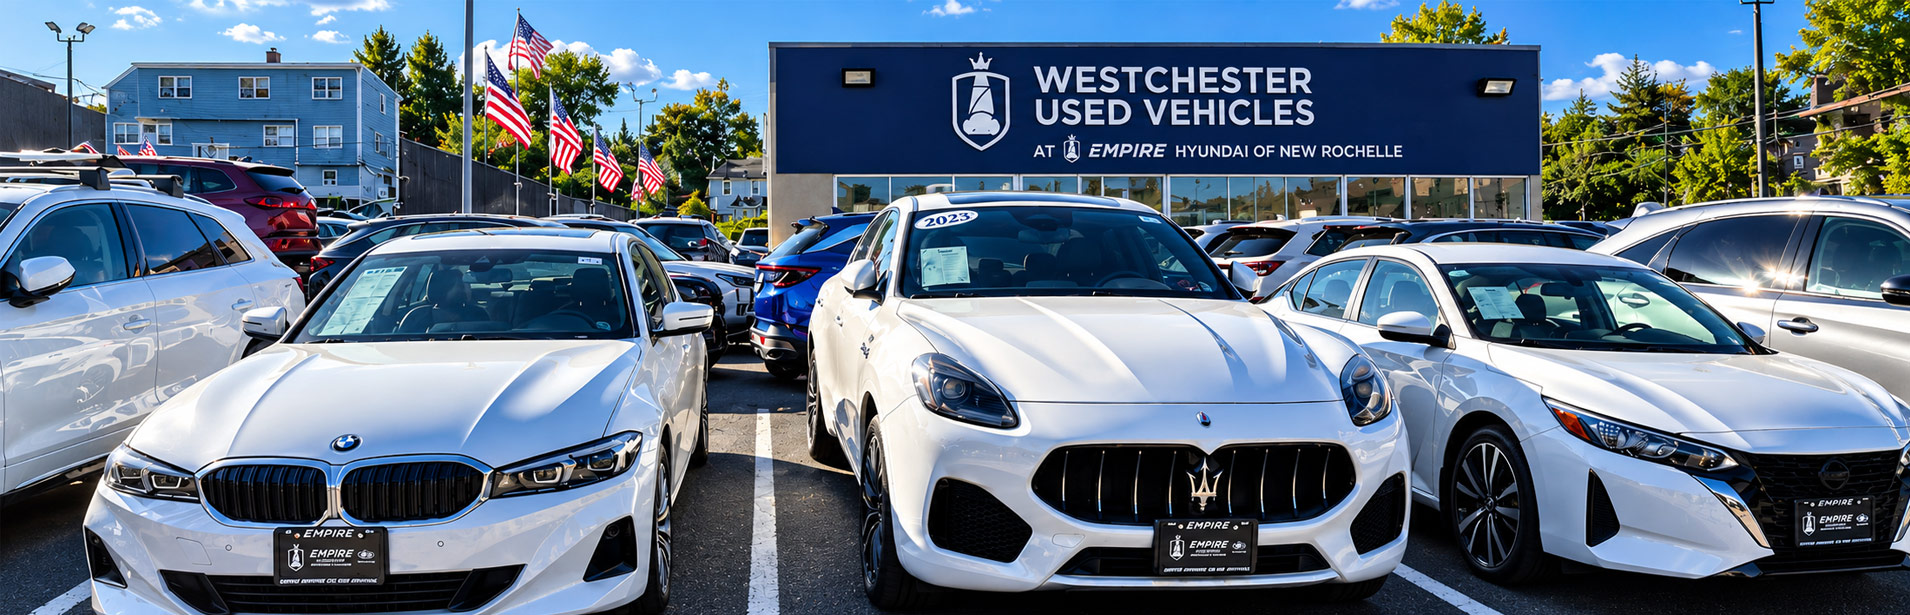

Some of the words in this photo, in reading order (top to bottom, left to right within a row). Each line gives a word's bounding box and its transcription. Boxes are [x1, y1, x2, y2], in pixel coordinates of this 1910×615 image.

[1033, 66, 1313, 94] WESTCHESTER
[1035, 98, 1132, 126] USED
[1143, 98, 1315, 126] VEHICLES
[1033, 144, 1055, 158] AT
[1088, 143, 1168, 158] EMPIRE
[1175, 144, 1249, 158] HYUNDAI
[1253, 144, 1275, 158] OF
[1279, 144, 1317, 158] NEW
[1321, 144, 1403, 158] ROCHELLE
[924, 212, 971, 228] 2023
[1817, 498, 1854, 507] EMPIRE
[1819, 514, 1854, 524] EMPIRE
[1186, 521, 1231, 530] EMPIRE
[303, 529, 355, 538] EMPIRE
[1189, 540, 1229, 549] EMPIRE
[309, 549, 355, 558] EMPIRE
